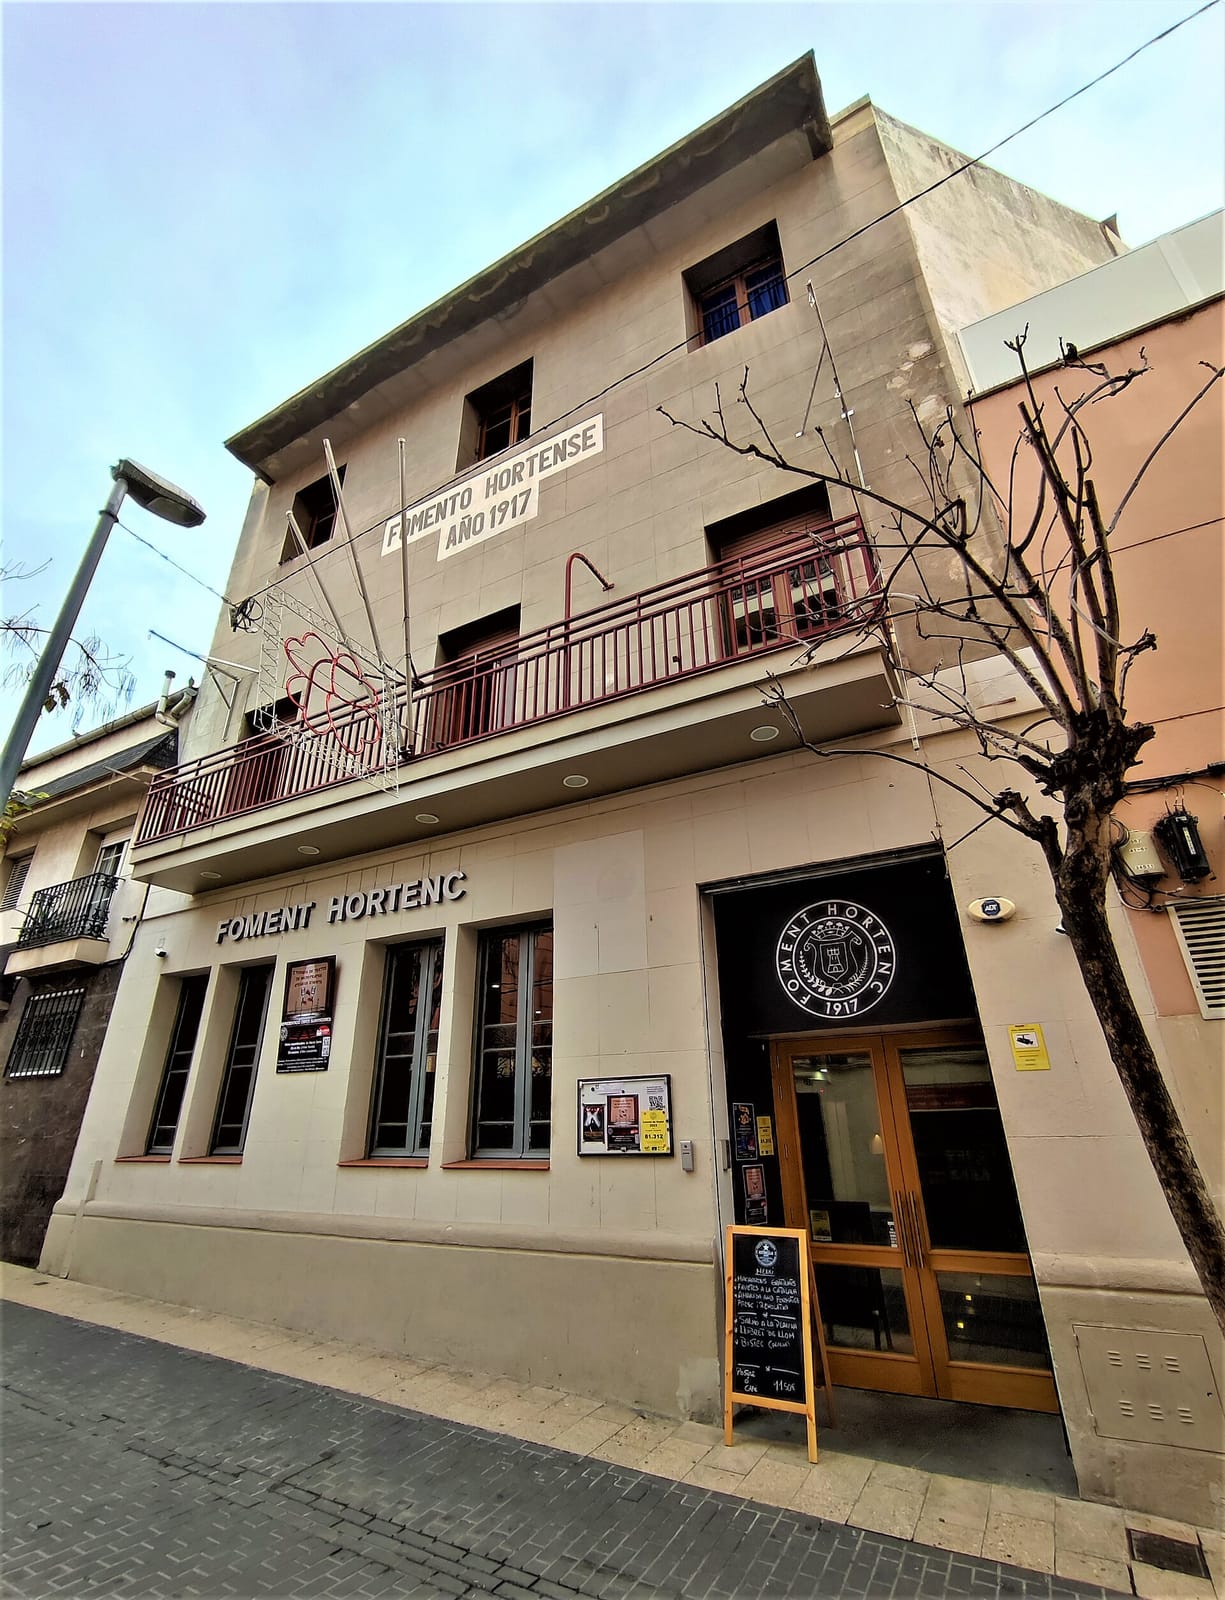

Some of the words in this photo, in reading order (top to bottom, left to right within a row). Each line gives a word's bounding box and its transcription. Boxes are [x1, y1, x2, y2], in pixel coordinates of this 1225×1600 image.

[485, 424, 597, 499] HORTENSE
[445, 512, 485, 550] AÑO
[489, 487, 533, 530] 1917
[216, 901, 317, 944] FOMENT
[326, 870, 468, 923] HORTENC
[780, 912, 812, 1006] FOMENT
[826, 903, 893, 994] HORTENC
[825, 997, 859, 1016] 1917
